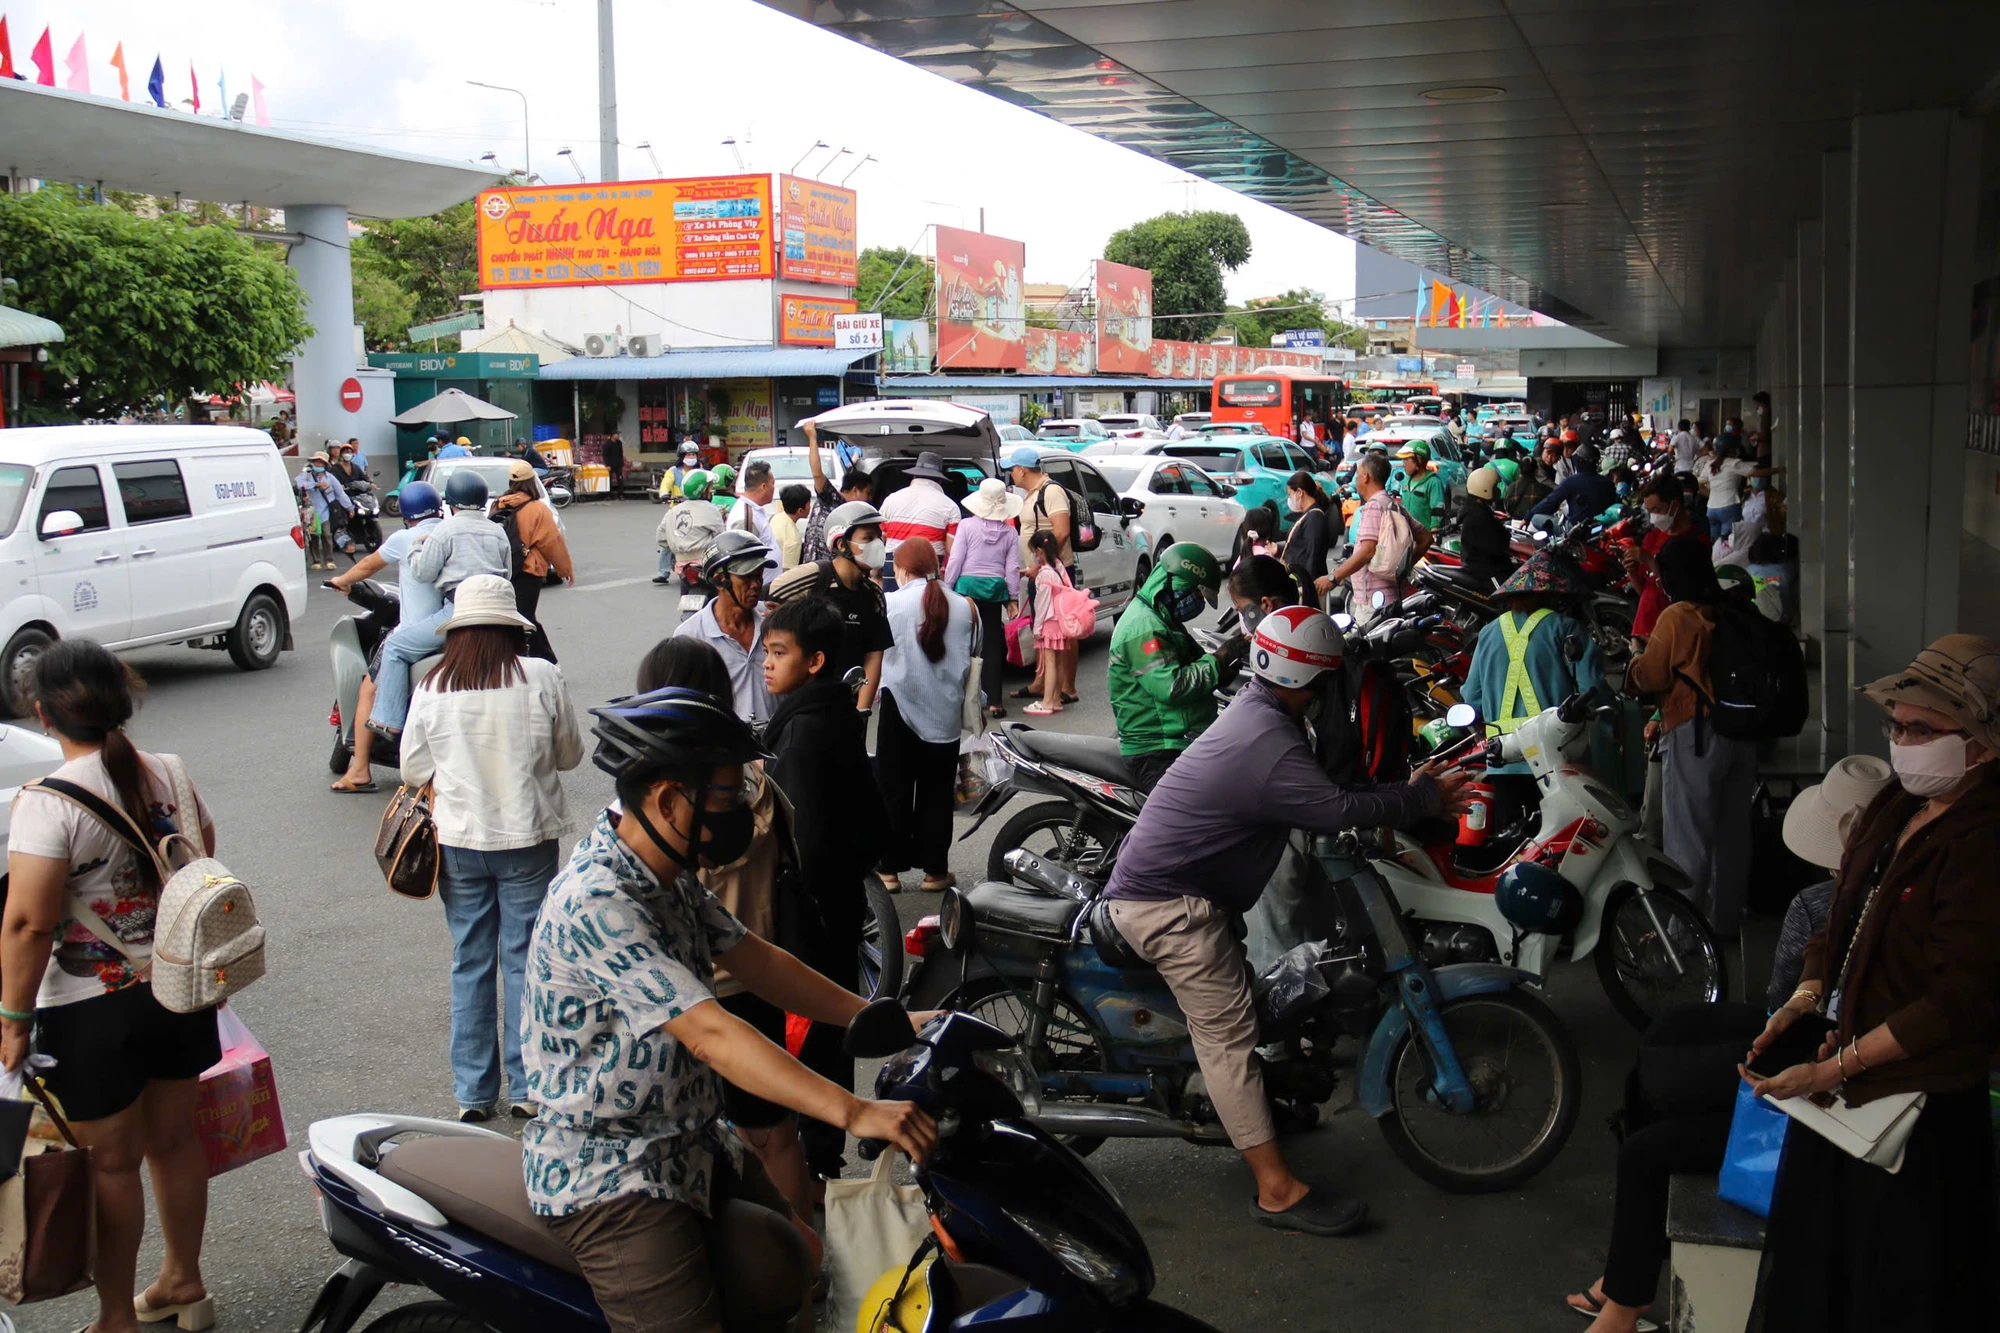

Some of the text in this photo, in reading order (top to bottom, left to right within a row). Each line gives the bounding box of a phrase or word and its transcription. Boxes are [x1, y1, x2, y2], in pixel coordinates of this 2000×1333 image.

[505, 206, 657, 246] Tuấn Nga
[706, 221, 717, 229] 34
[718, 220, 742, 230] Phòng
[744, 219, 758, 229] Vip
[736, 232, 747, 240] Cao
[748, 230, 760, 241] Cấp
[491, 249, 521, 263] CHUYỂN
[523, 250, 544, 262] PHÁT
[545, 247, 575, 261] NHANH
[619, 245, 641, 257] HÀNG
[491, 259, 661, 281] TP. HCM KIÊN GIANG HÀ TIÊN
[798, 308, 823, 327] Tuấn
[852, 317, 868, 329] GIỮ
[869, 319, 880, 328] XE
[849, 331, 869, 344] SỐ 2
[1286, 330, 1298, 340] NHÀ
[1306, 331, 1319, 339] SINH
[385, 358, 446, 372] AUTOBANK BIDV
[509, 358, 526, 372] BIDV
[1180, 559, 1207, 579] Grab
[386, 1226, 483, 1278] VISION
